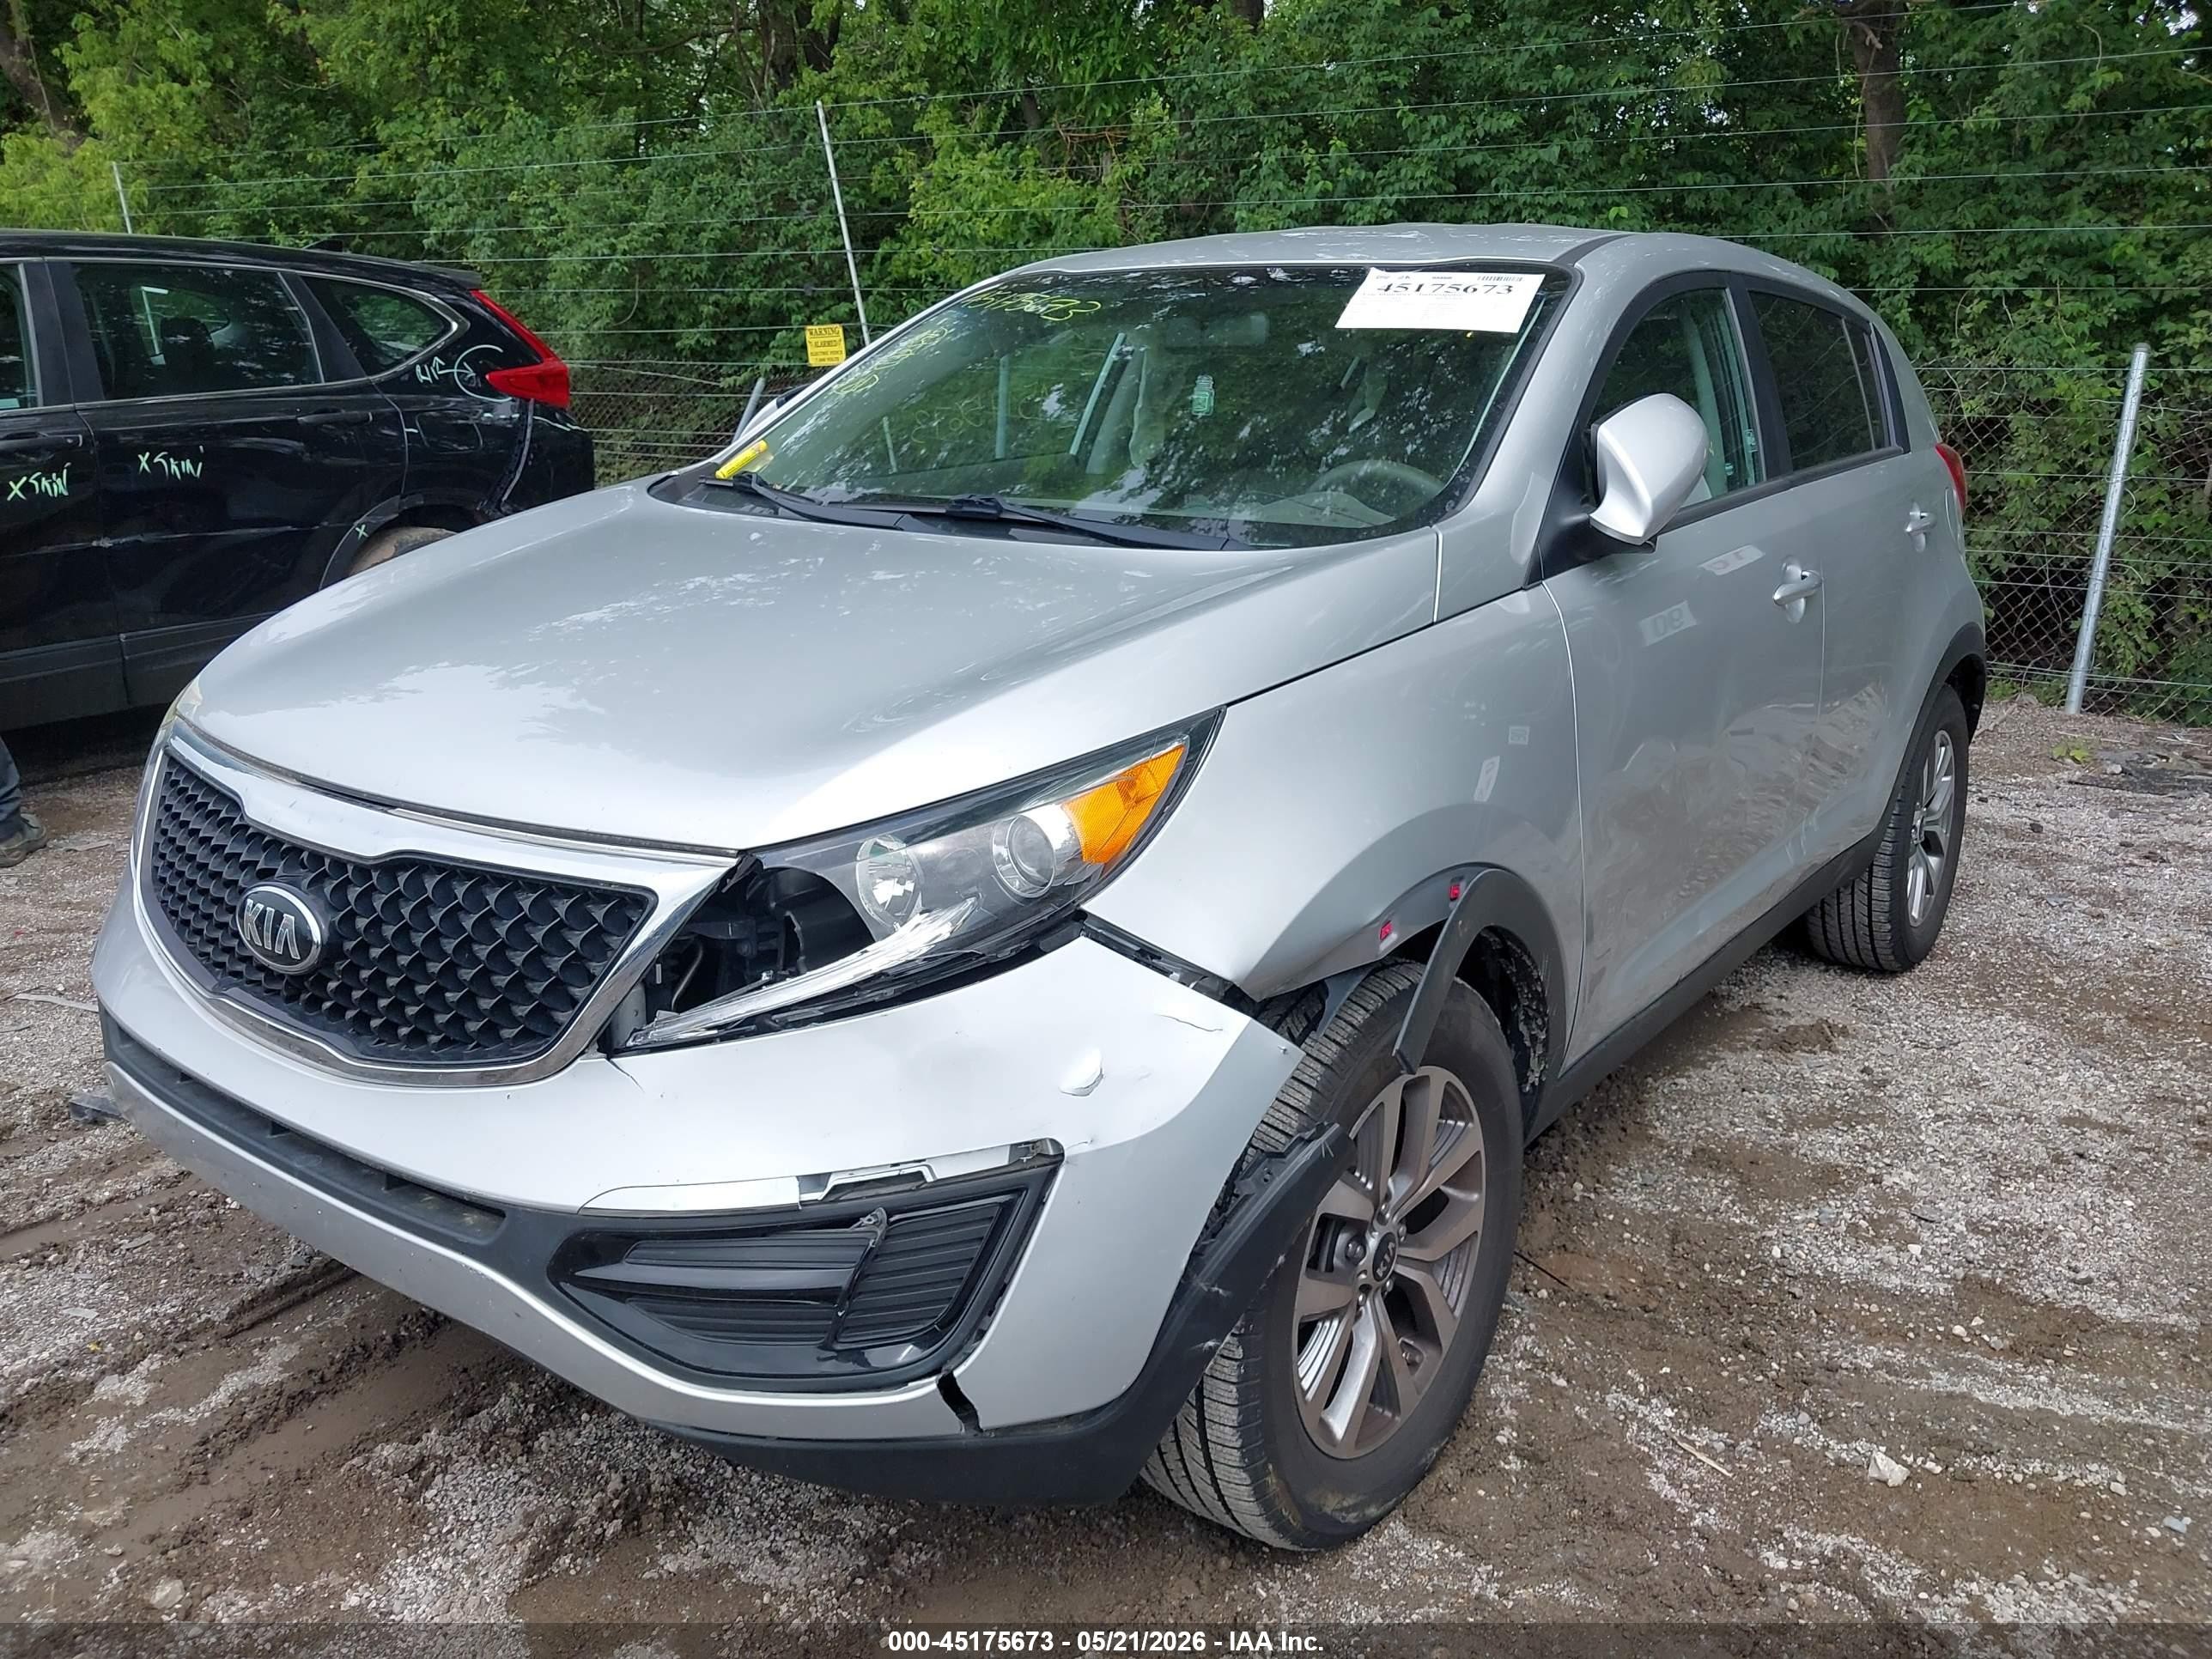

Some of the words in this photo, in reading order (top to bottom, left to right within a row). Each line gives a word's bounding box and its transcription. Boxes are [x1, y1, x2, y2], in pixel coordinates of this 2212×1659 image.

[1376, 283, 1514, 295] 45175673
[808, 327, 840, 336] WARNING
[243, 898, 301, 960] KIA
[1376, 1242, 1395, 1278] KIA
